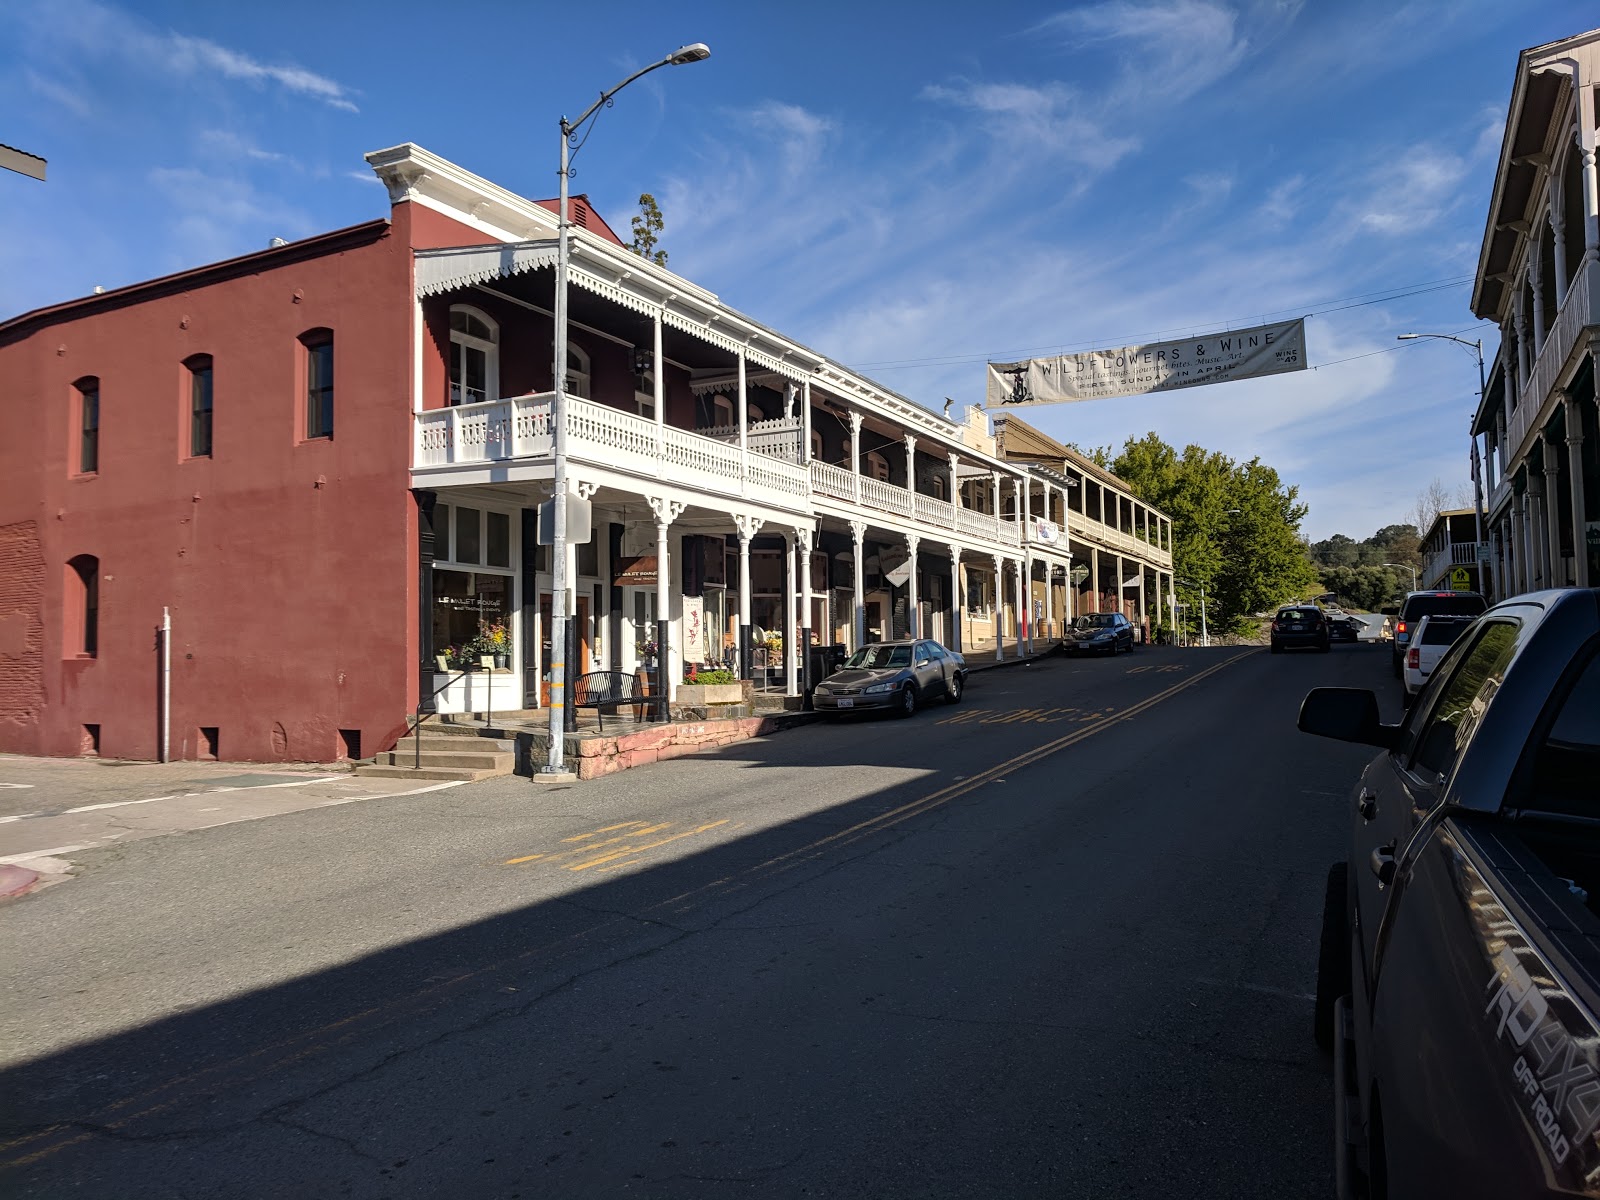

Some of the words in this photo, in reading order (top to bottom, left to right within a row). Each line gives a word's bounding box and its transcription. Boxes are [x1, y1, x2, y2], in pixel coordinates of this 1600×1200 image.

[1042, 349, 1180, 376] WILDFLOWERS
[1196, 344, 1206, 356] &
[1220, 332, 1275, 352] WINE
[1195, 356, 1223, 366] Music.
[1227, 352, 1245, 360] Art.
[1275, 349, 1297, 357] WINE
[1284, 355, 1297, 363] 49
[1079, 380, 1113, 389] FIRST
[1121, 373, 1169, 384] SUNDAY
[1197, 364, 1236, 374] APRIL
[1513, 1055, 1539, 1098] OFF
[1531, 1097, 1570, 1165] ROAD
